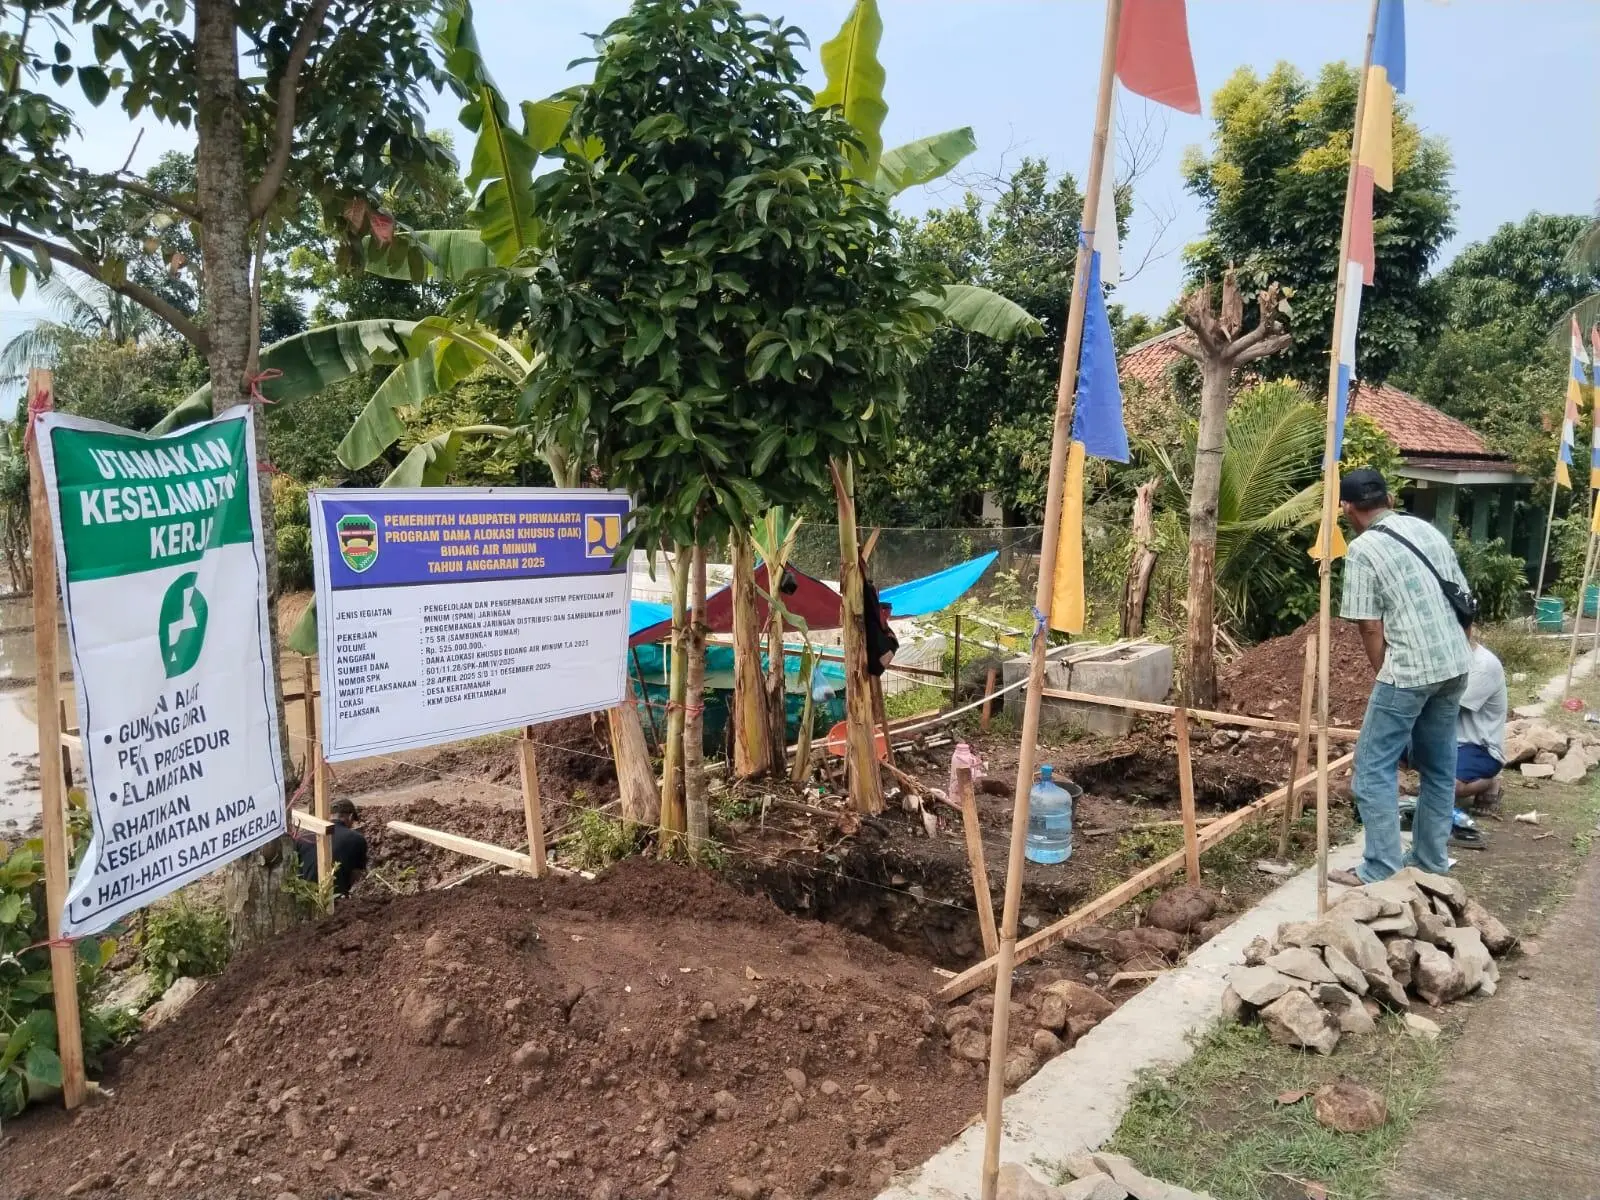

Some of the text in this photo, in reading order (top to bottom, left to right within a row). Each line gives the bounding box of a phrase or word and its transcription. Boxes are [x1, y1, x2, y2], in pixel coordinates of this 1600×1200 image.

[88, 438, 232, 480] UTAMAKAN
[384, 513, 581, 526] PEMERINTAH KABUPATEN PURWAKARTA
[385, 530, 440, 542] PROGRAM
[443, 529, 471, 541] DANA
[474, 528, 514, 540] ALOKASI
[517, 528, 555, 539] KHUSUS
[557, 527, 582, 540] (DAK)
[440, 543, 537, 557] BIDANG AIR MINUM
[427, 557, 545, 573] TAHUN ANGGARAN 2025
[336, 610, 358, 620] JENIS
[424, 602, 472, 612] PENGELOLAAN
[474, 601, 489, 609] DAN
[490, 597, 543, 607] PENGEMBANGAN
[544, 595, 566, 604] SISTEM
[568, 592, 605, 602] PENYEDIAAN
[423, 609, 511, 623] MINUM (SPAM) JARINGAN
[337, 631, 378, 642] PEKERJAAN
[424, 623, 482, 633] PENGEMBANGAN
[483, 619, 515, 629] JARINGAN
[517, 616, 552, 625] DISTRIBUSI
[553, 614, 565, 622] DAN
[567, 611, 604, 620] SAMBUNGAN
[337, 628, 520, 653] VOLUME 75 SR (SAMBUNGAN RUMAH)
[337, 653, 376, 664] ANGGARAN
[338, 664, 368, 675] SUMBER
[370, 662, 389, 671] DANA
[426, 656, 445, 665] DANA
[446, 652, 474, 662] ALOKASI
[476, 649, 503, 658] KHUSUS
[504, 646, 527, 655] BIDANG
[529, 645, 540, 653] AIR
[541, 642, 563, 651] MINUM
[338, 676, 365, 686] NOMOR
[367, 673, 381, 682] SPK
[339, 687, 365, 697] WAKTU
[365, 680, 417, 693] PELAKSANAAN
[426, 677, 436, 686] 28
[437, 674, 458, 684] APRIL
[459, 672, 476, 681] 2025
[500, 664, 534, 676] DESEMBER
[535, 662, 551, 671] 2025
[339, 680, 491, 708] LOKASI DESA KERTAMANAH
[339, 688, 507, 719] PELAKSANA KKM DESA KERTAMANAH
[154, 729, 230, 771] PROSEDUR
[105, 795, 191, 846] RHATIKAN
[215, 795, 256, 826] ANDA
[97, 809, 278, 906] HATI-HATI SAAT BEKERJA
